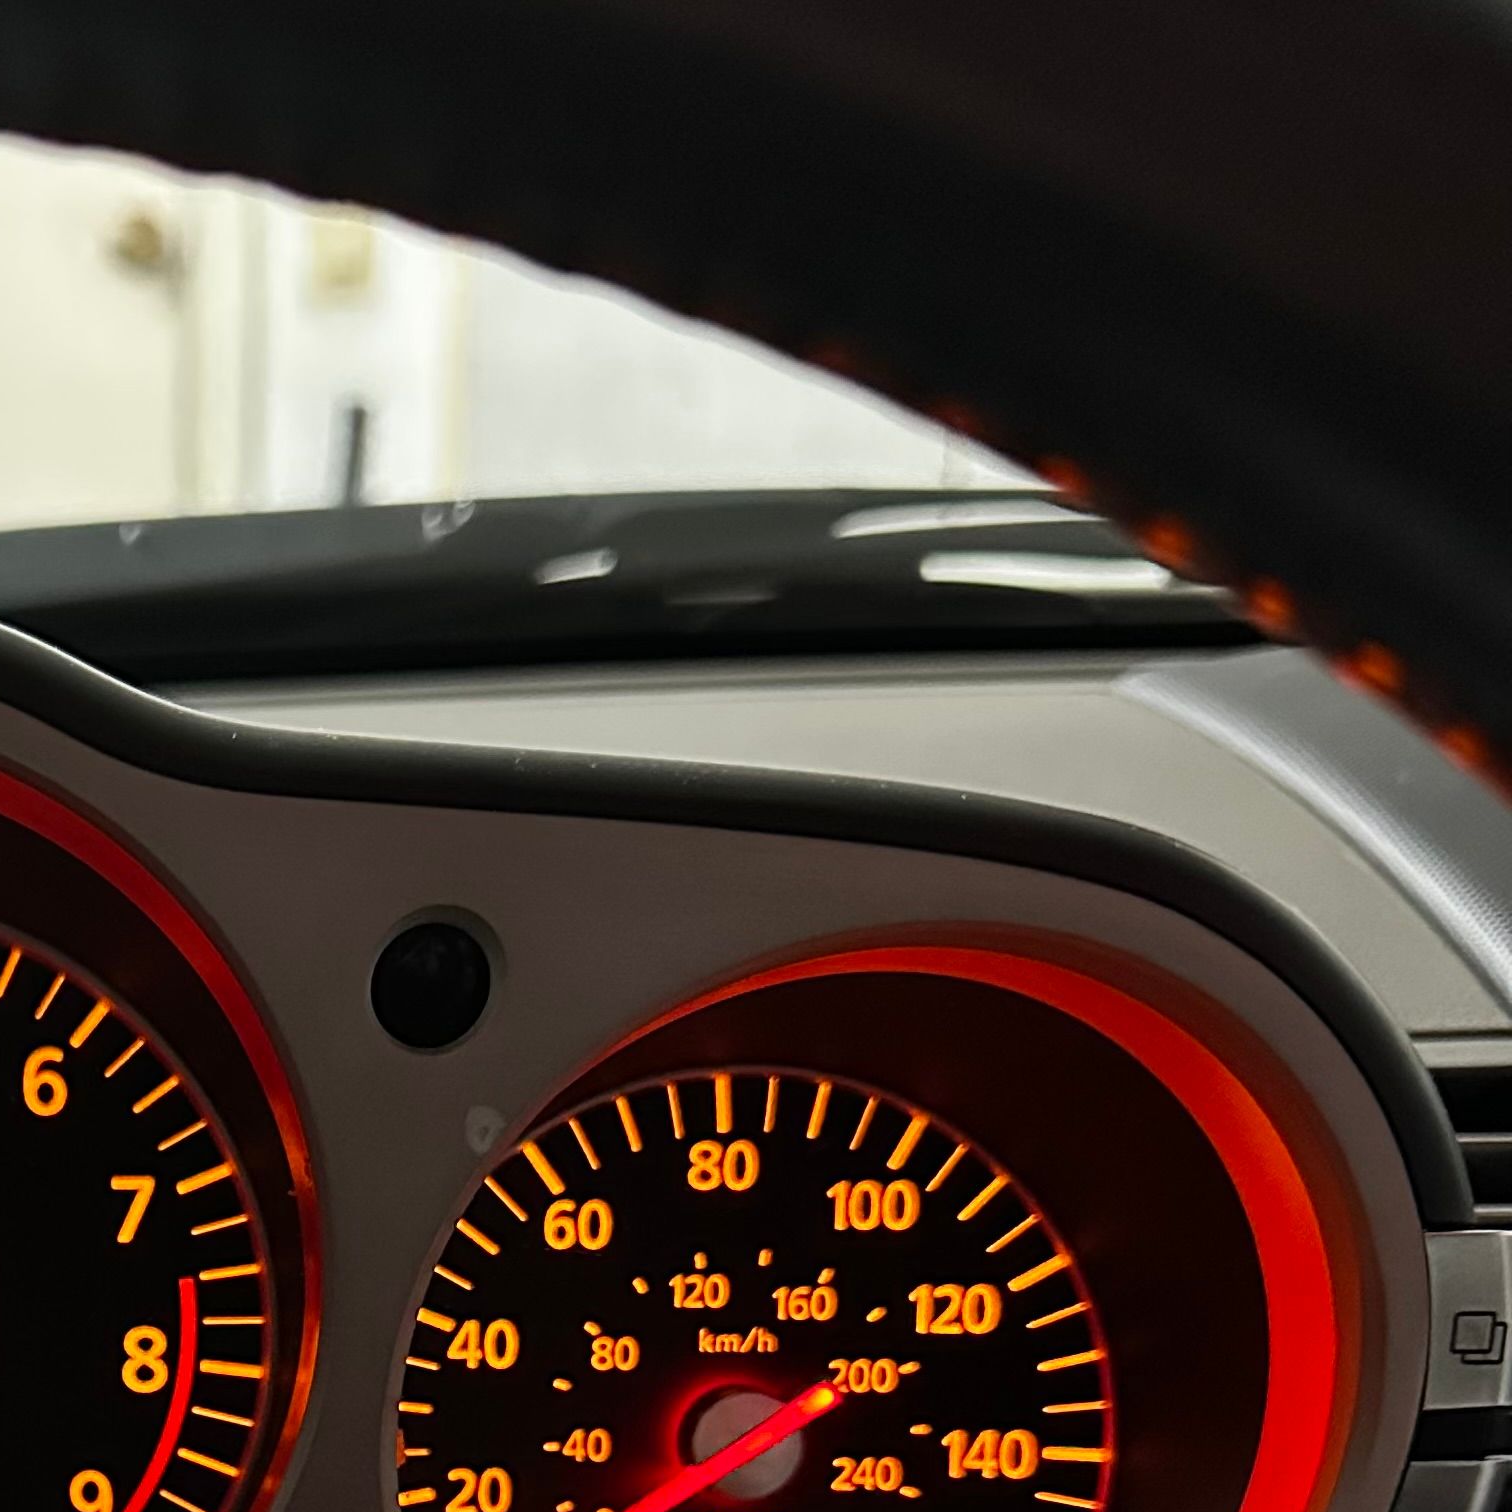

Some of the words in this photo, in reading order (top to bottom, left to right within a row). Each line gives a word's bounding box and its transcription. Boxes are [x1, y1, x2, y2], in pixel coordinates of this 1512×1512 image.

[23, 1047, 69, 1116] 6
[687, 1140, 759, 1191] 80
[110, 1176, 155, 1243] 7
[544, 1199, 614, 1250] 60
[827, 1180, 919, 1230] 100
[669, 1274, 730, 1308] 120
[772, 1286, 837, 1321] 160
[909, 1284, 1001, 1334] 120
[121, 1326, 168, 1393] 8
[447, 1318, 520, 1369] 40
[591, 1336, 640, 1371] 80
[699, 1327, 778, 1354] km/h
[829, 1358, 898, 1393] 200
[562, 1428, 611, 1462] 40
[941, 1429, 1037, 1479] 140
[831, 1456, 904, 1492] 240
